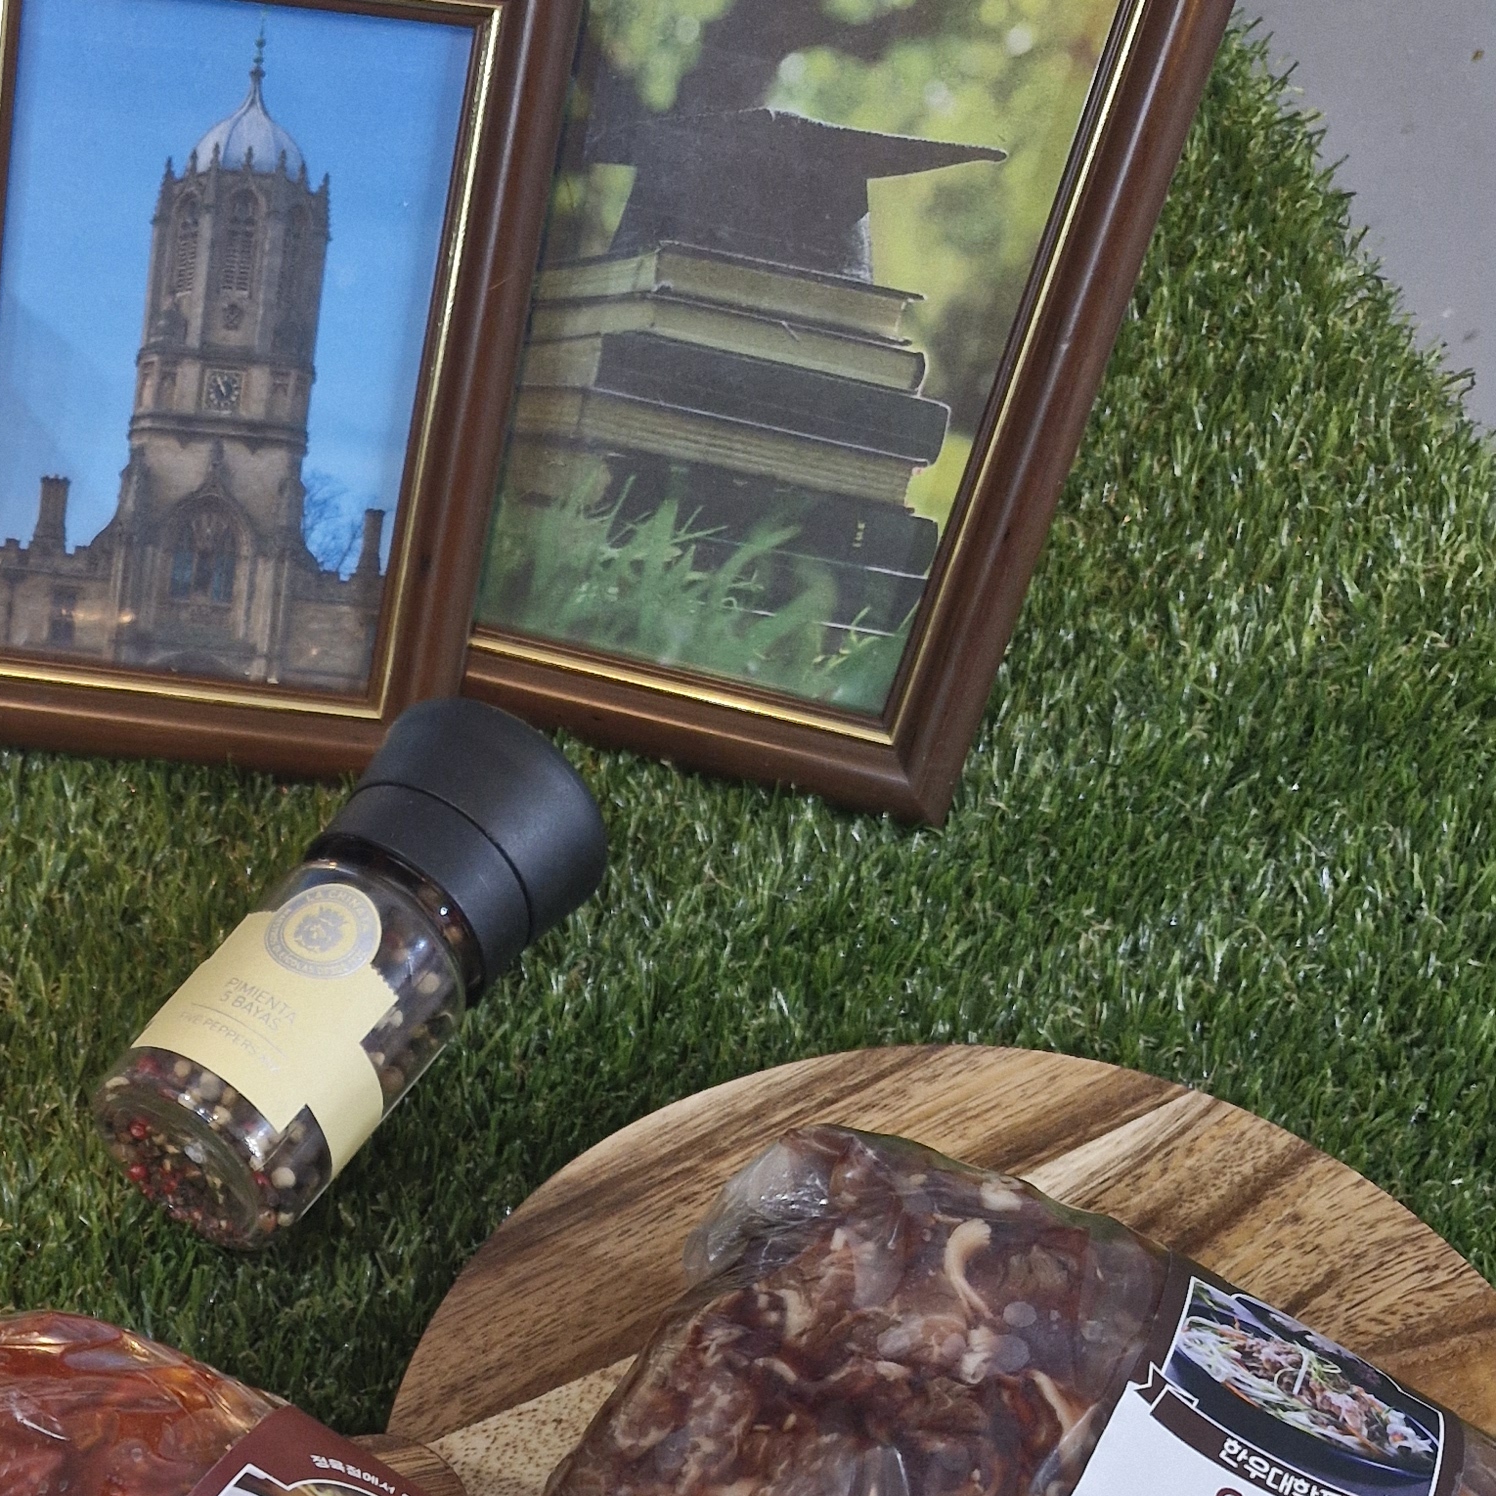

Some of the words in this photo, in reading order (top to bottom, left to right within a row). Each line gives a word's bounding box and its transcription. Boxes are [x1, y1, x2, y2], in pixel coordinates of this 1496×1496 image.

[224, 977, 296, 1024] PIMIENTA
[231, 995, 281, 1031] BAYAS
[310, 1454, 396, 1495] 정육점에서
